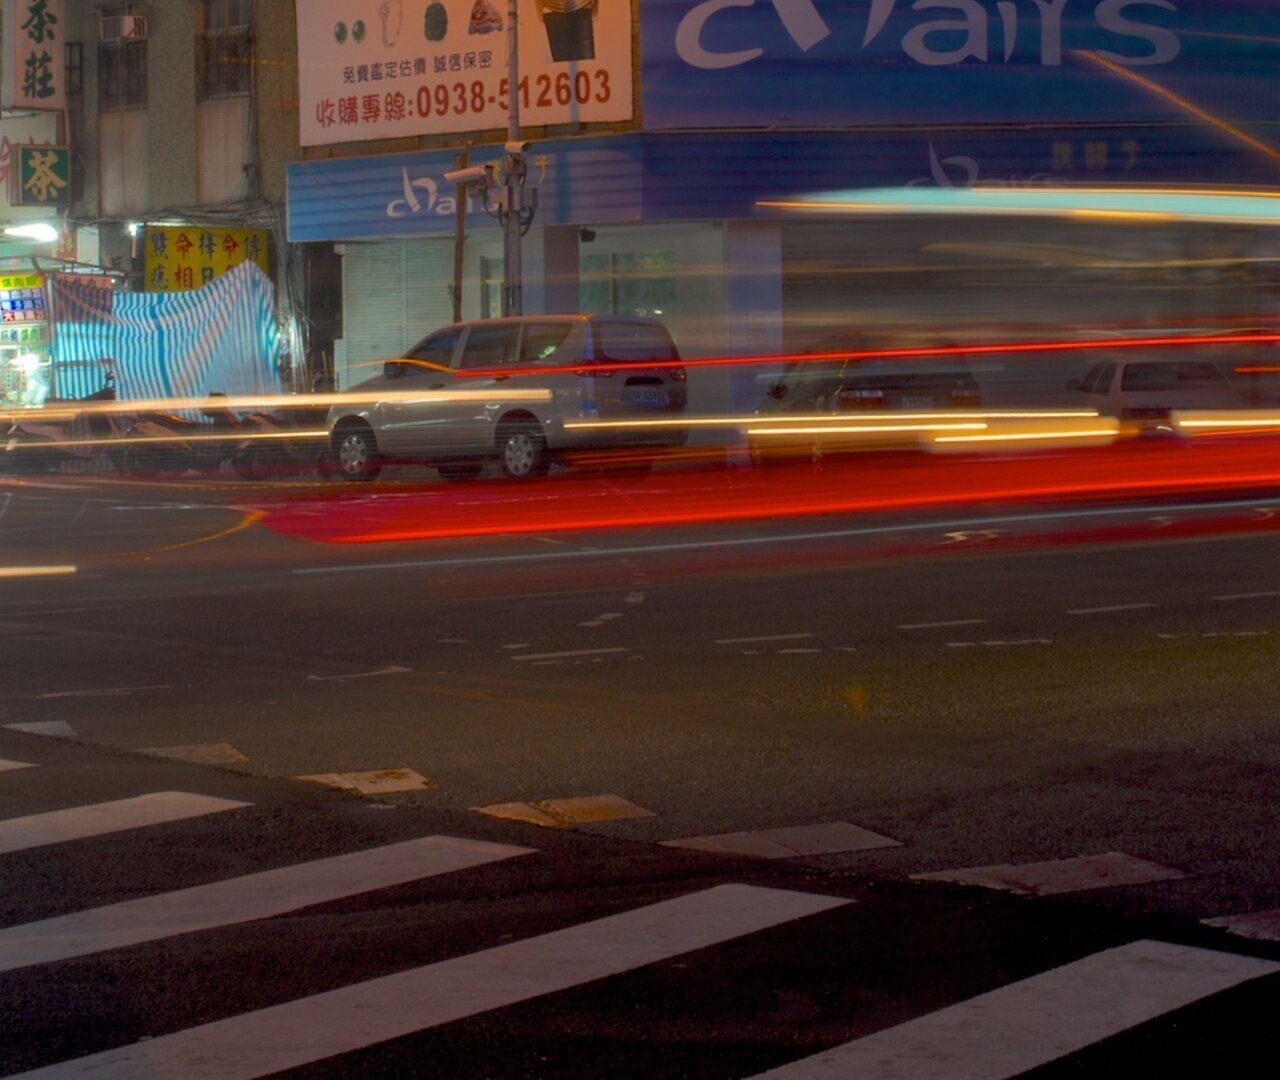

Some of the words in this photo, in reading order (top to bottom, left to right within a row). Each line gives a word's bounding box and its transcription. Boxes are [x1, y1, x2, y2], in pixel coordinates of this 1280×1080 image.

[433, 50, 493, 74] 誠信保密
[24, 149, 67, 202] 茶
